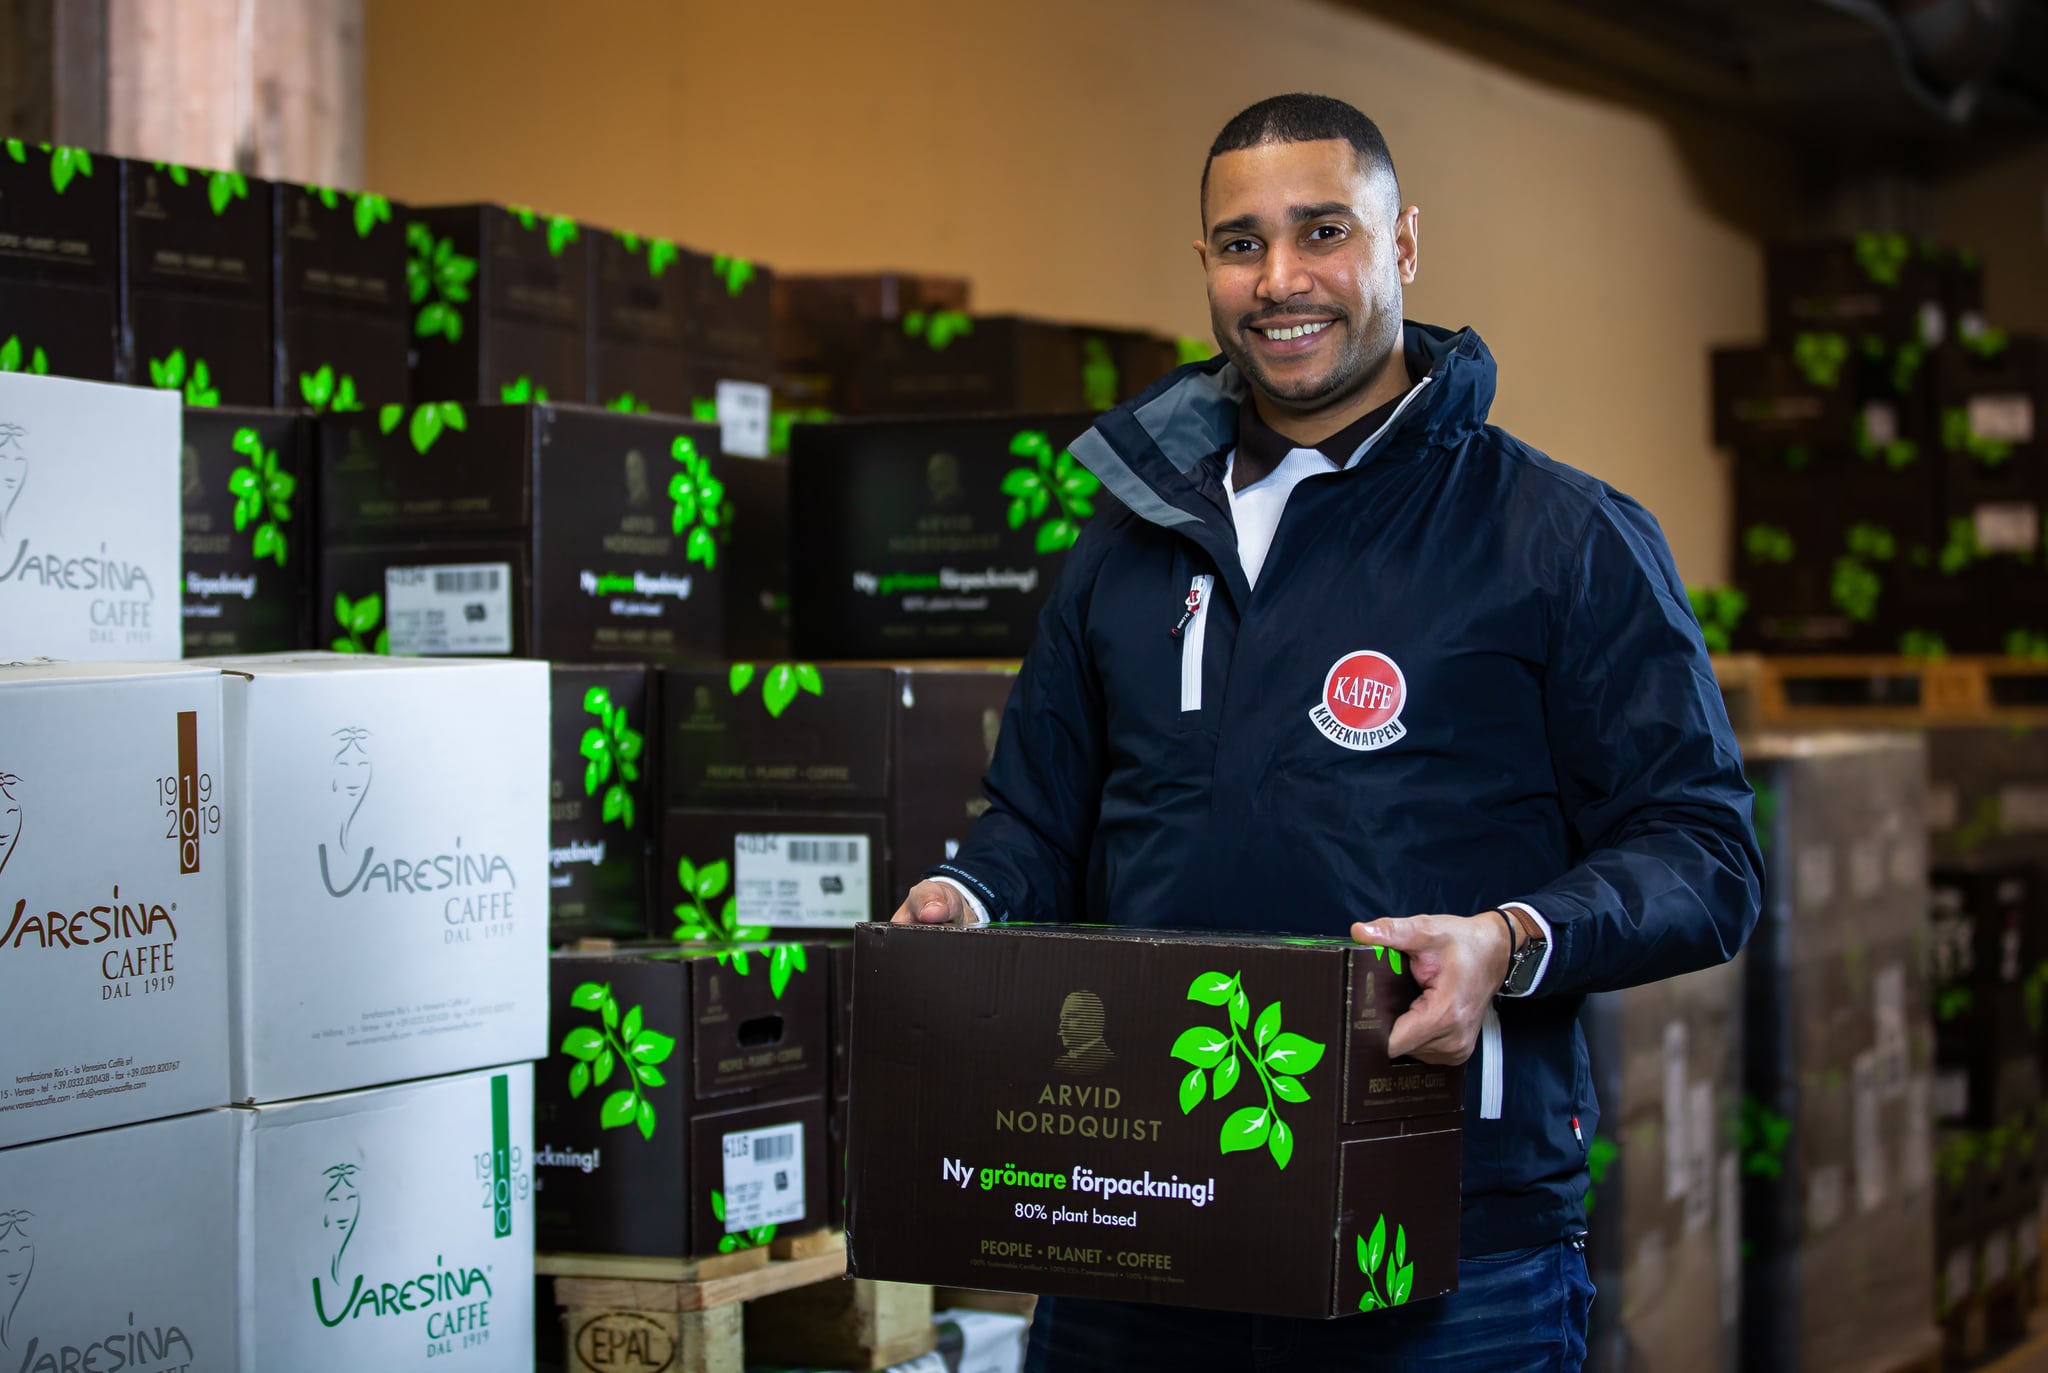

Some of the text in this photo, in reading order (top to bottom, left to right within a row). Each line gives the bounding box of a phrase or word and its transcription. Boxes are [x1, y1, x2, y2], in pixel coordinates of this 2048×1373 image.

[89, 599, 152, 628] CAFFE
[1332, 676, 1394, 709] KAFFE
[1313, 707, 1402, 746] KAFFEKNAPPEN
[444, 891, 514, 925] CAFFE
[444, 927, 471, 944] DAL
[102, 943, 174, 980] CAFFE
[102, 975, 174, 1001] DAL 1919
[1038, 1083, 1121, 1109] ARVID
[996, 1109, 1162, 1142] NORDQUIST
[533, 1144, 600, 1173] ckning!
[943, 1157, 1215, 1207] Ny grönare förpackning!
[1014, 1202, 1137, 1227] 80% plant based
[981, 1240, 1172, 1270] PEOPLE PLANET COFFEE
[427, 1301, 489, 1339] CAFFE
[19, 1311, 193, 1373] ARESINA
[427, 1330, 490, 1358] DAL 1919
[592, 1327, 660, 1367] EPAL
